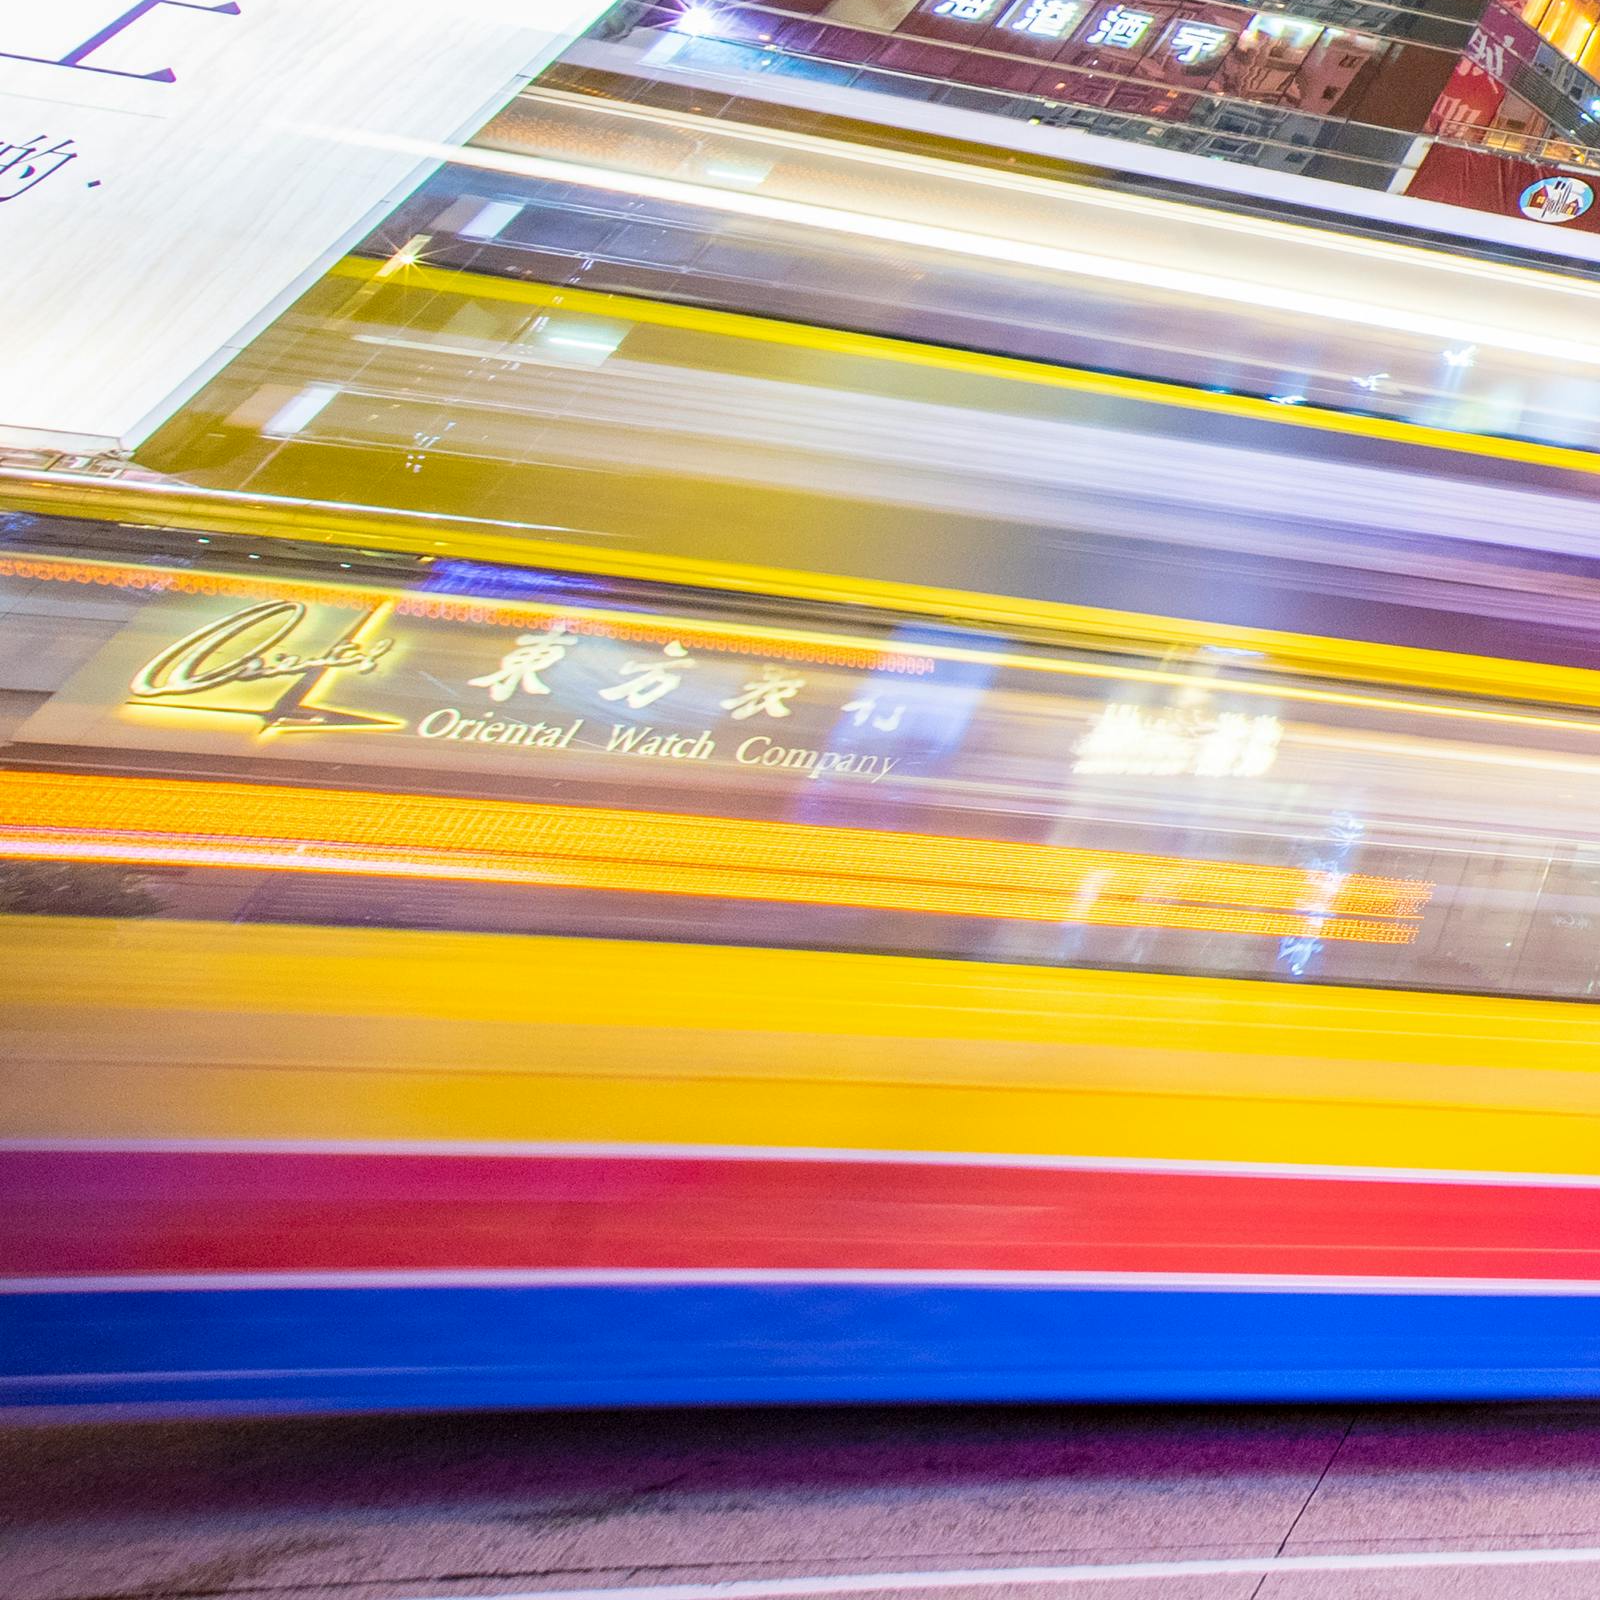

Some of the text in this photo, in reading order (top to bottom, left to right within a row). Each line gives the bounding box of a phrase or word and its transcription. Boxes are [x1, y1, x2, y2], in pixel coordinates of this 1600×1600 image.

[417, 707, 900, 783] Oriental Watch Company
